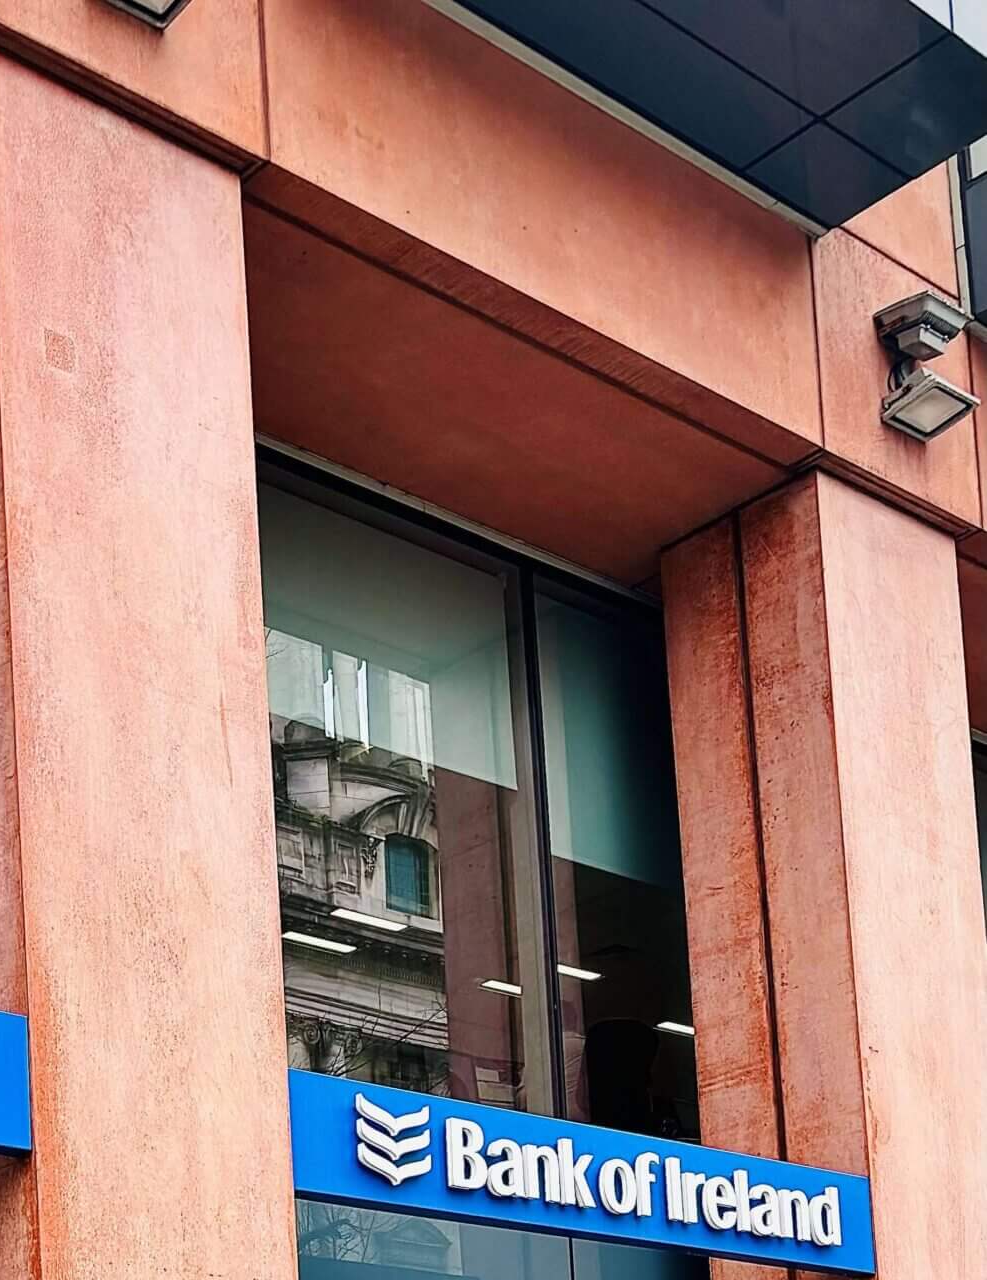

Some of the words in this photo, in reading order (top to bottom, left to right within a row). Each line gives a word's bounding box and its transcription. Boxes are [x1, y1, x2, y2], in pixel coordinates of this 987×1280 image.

[444, 1117, 596, 1208] Bank
[598, 1151, 660, 1217] of
[666, 1157, 842, 1246] Ireland
